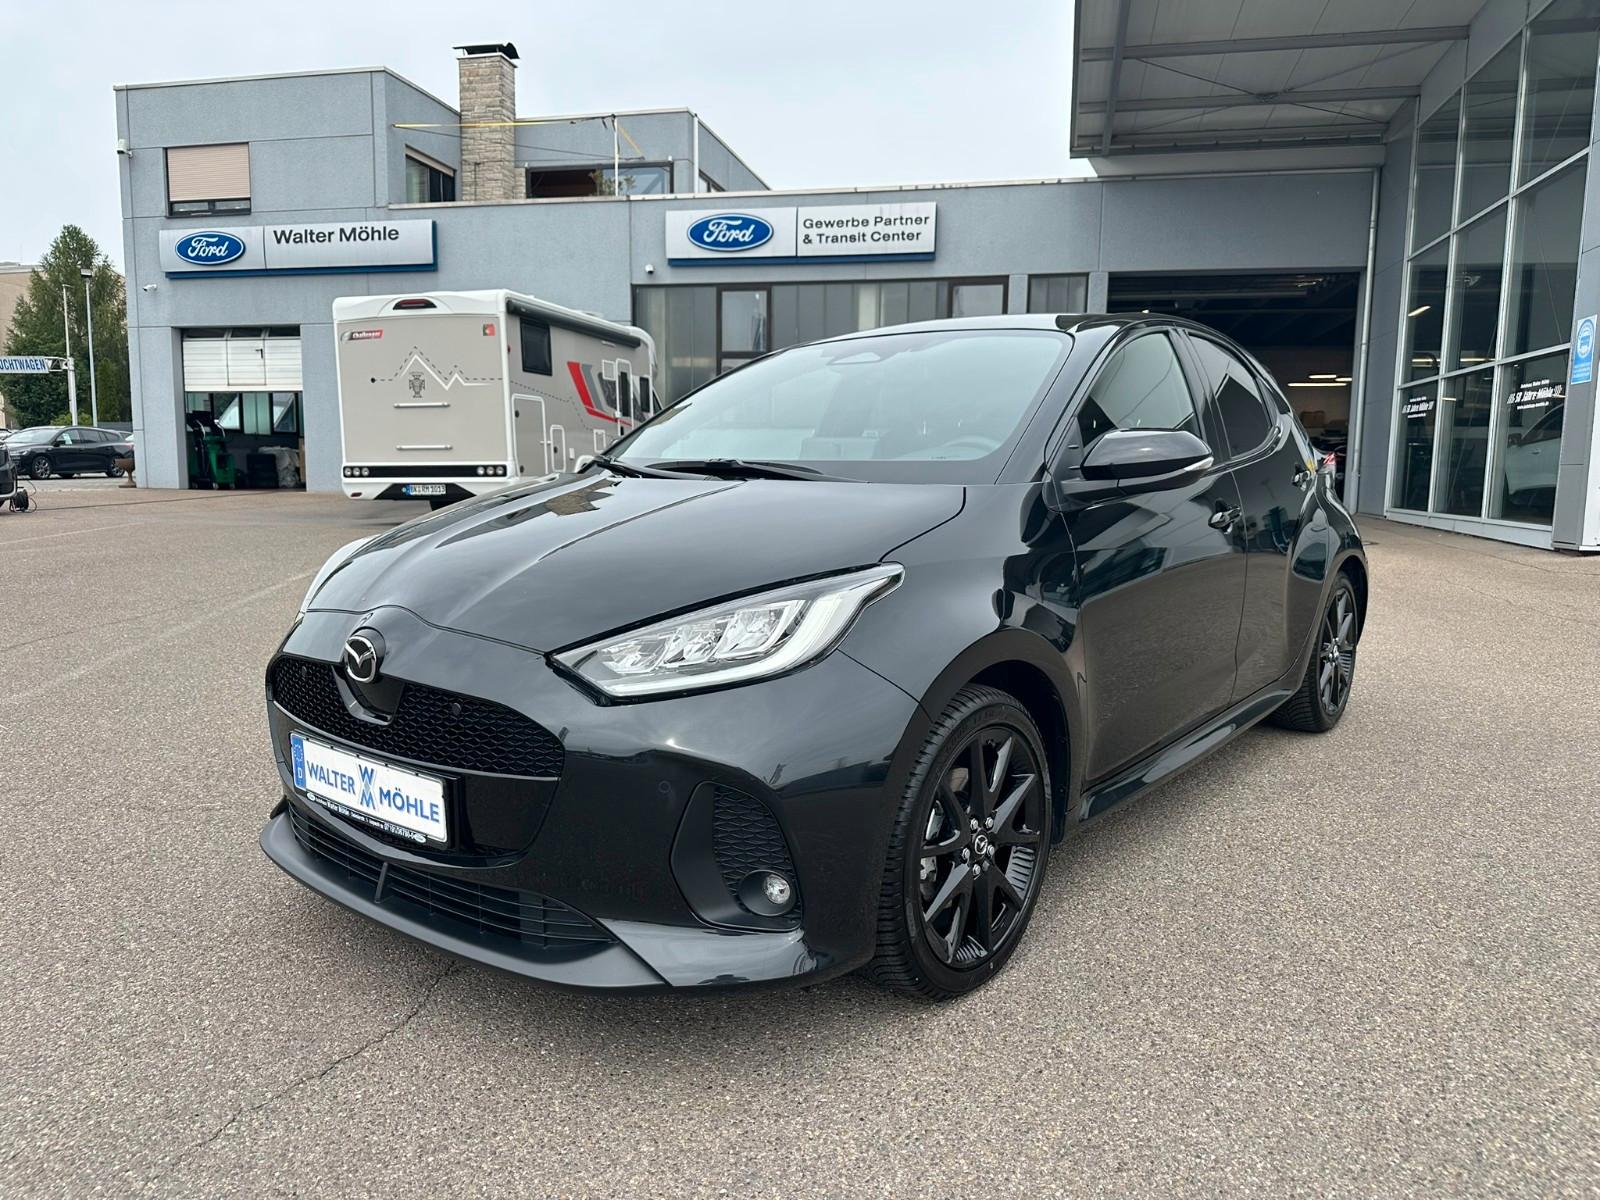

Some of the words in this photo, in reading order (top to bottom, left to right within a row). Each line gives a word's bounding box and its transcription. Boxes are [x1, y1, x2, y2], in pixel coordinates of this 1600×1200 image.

[703, 219, 755, 242] Ford
[803, 217, 869, 229] Gewerbe
[874, 215, 930, 227] Partner
[273, 229, 334, 244] Walter
[339, 226, 399, 242] Möhle
[803, 234, 813, 244] &
[816, 232, 866, 243] Transit
[870, 231, 921, 242] Center
[187, 236, 229, 257] Ford
[306, 760, 356, 796] WALTER
[379, 786, 440, 823] MÖHLE
